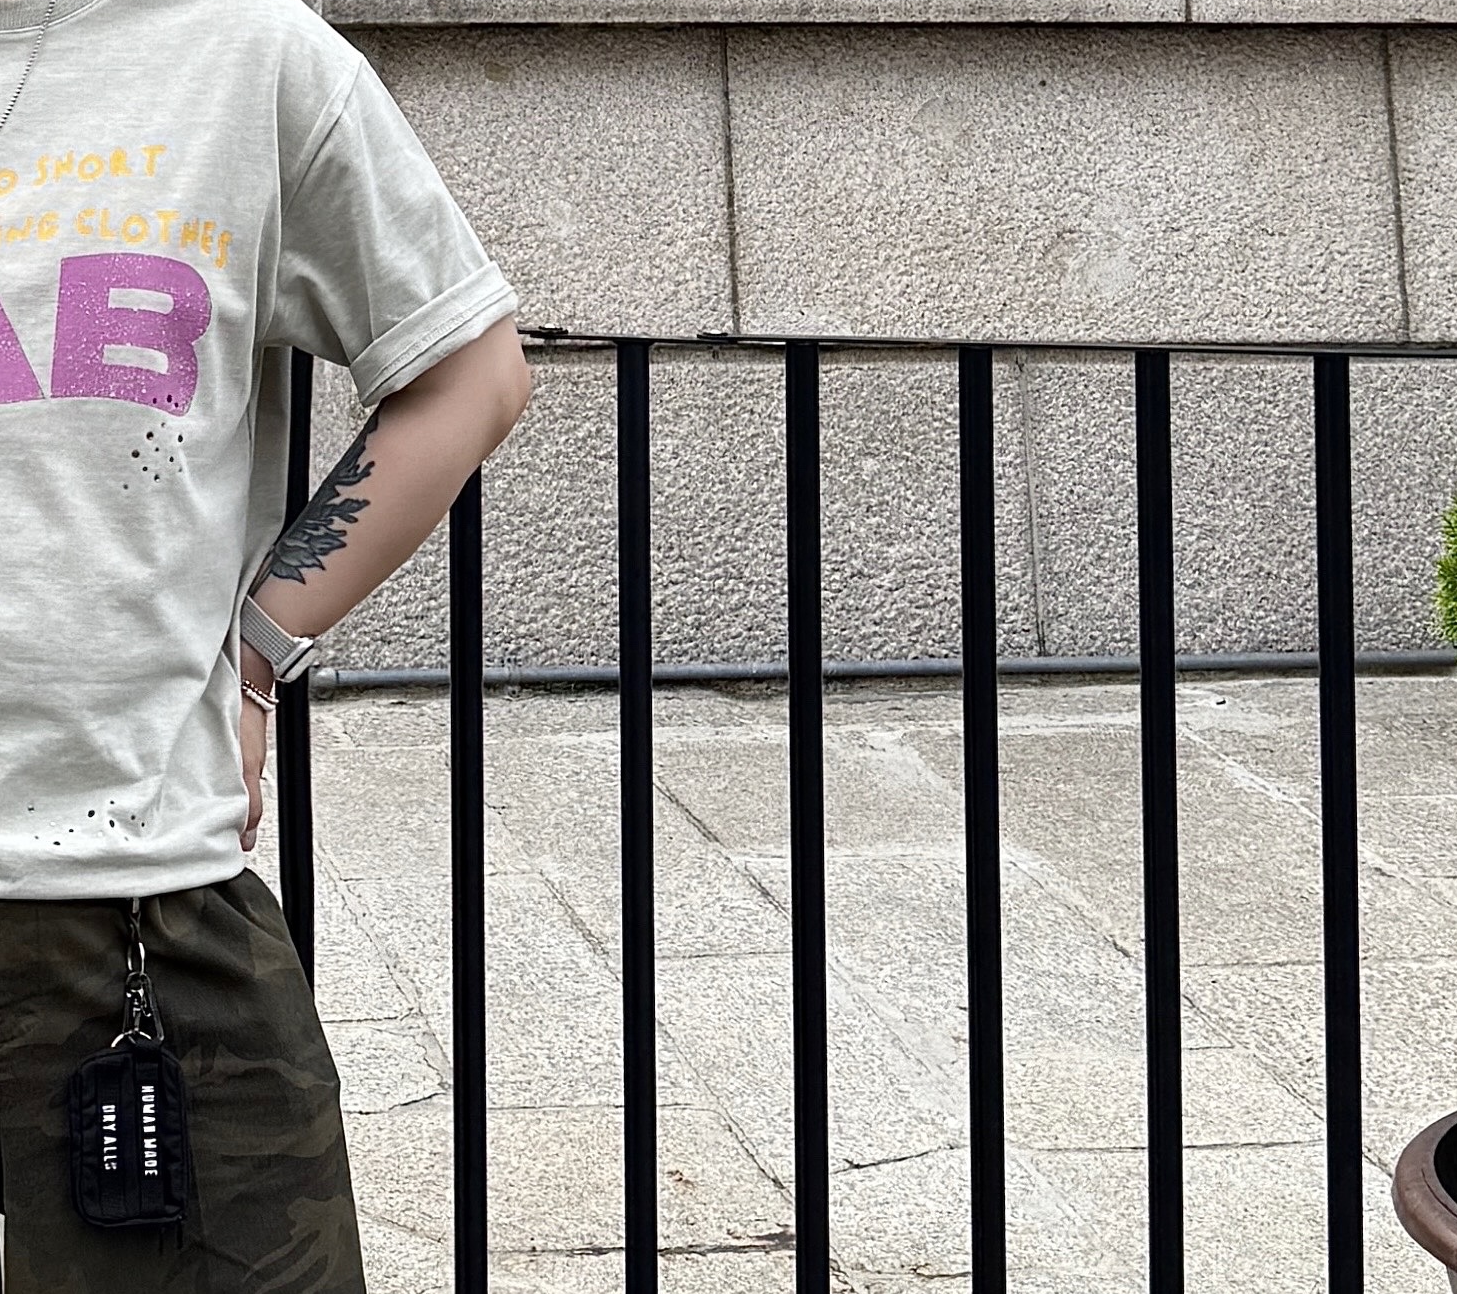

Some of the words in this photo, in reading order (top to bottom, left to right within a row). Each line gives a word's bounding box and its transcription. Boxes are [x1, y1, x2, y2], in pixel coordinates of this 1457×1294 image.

[33, 144, 167, 187] SHORT
[75, 208, 233, 269] CLOTHES
[102, 1104, 116, 1132] DRY
[141, 1085, 156, 1133] HUMAN
[143, 1138, 158, 1176] MADE
